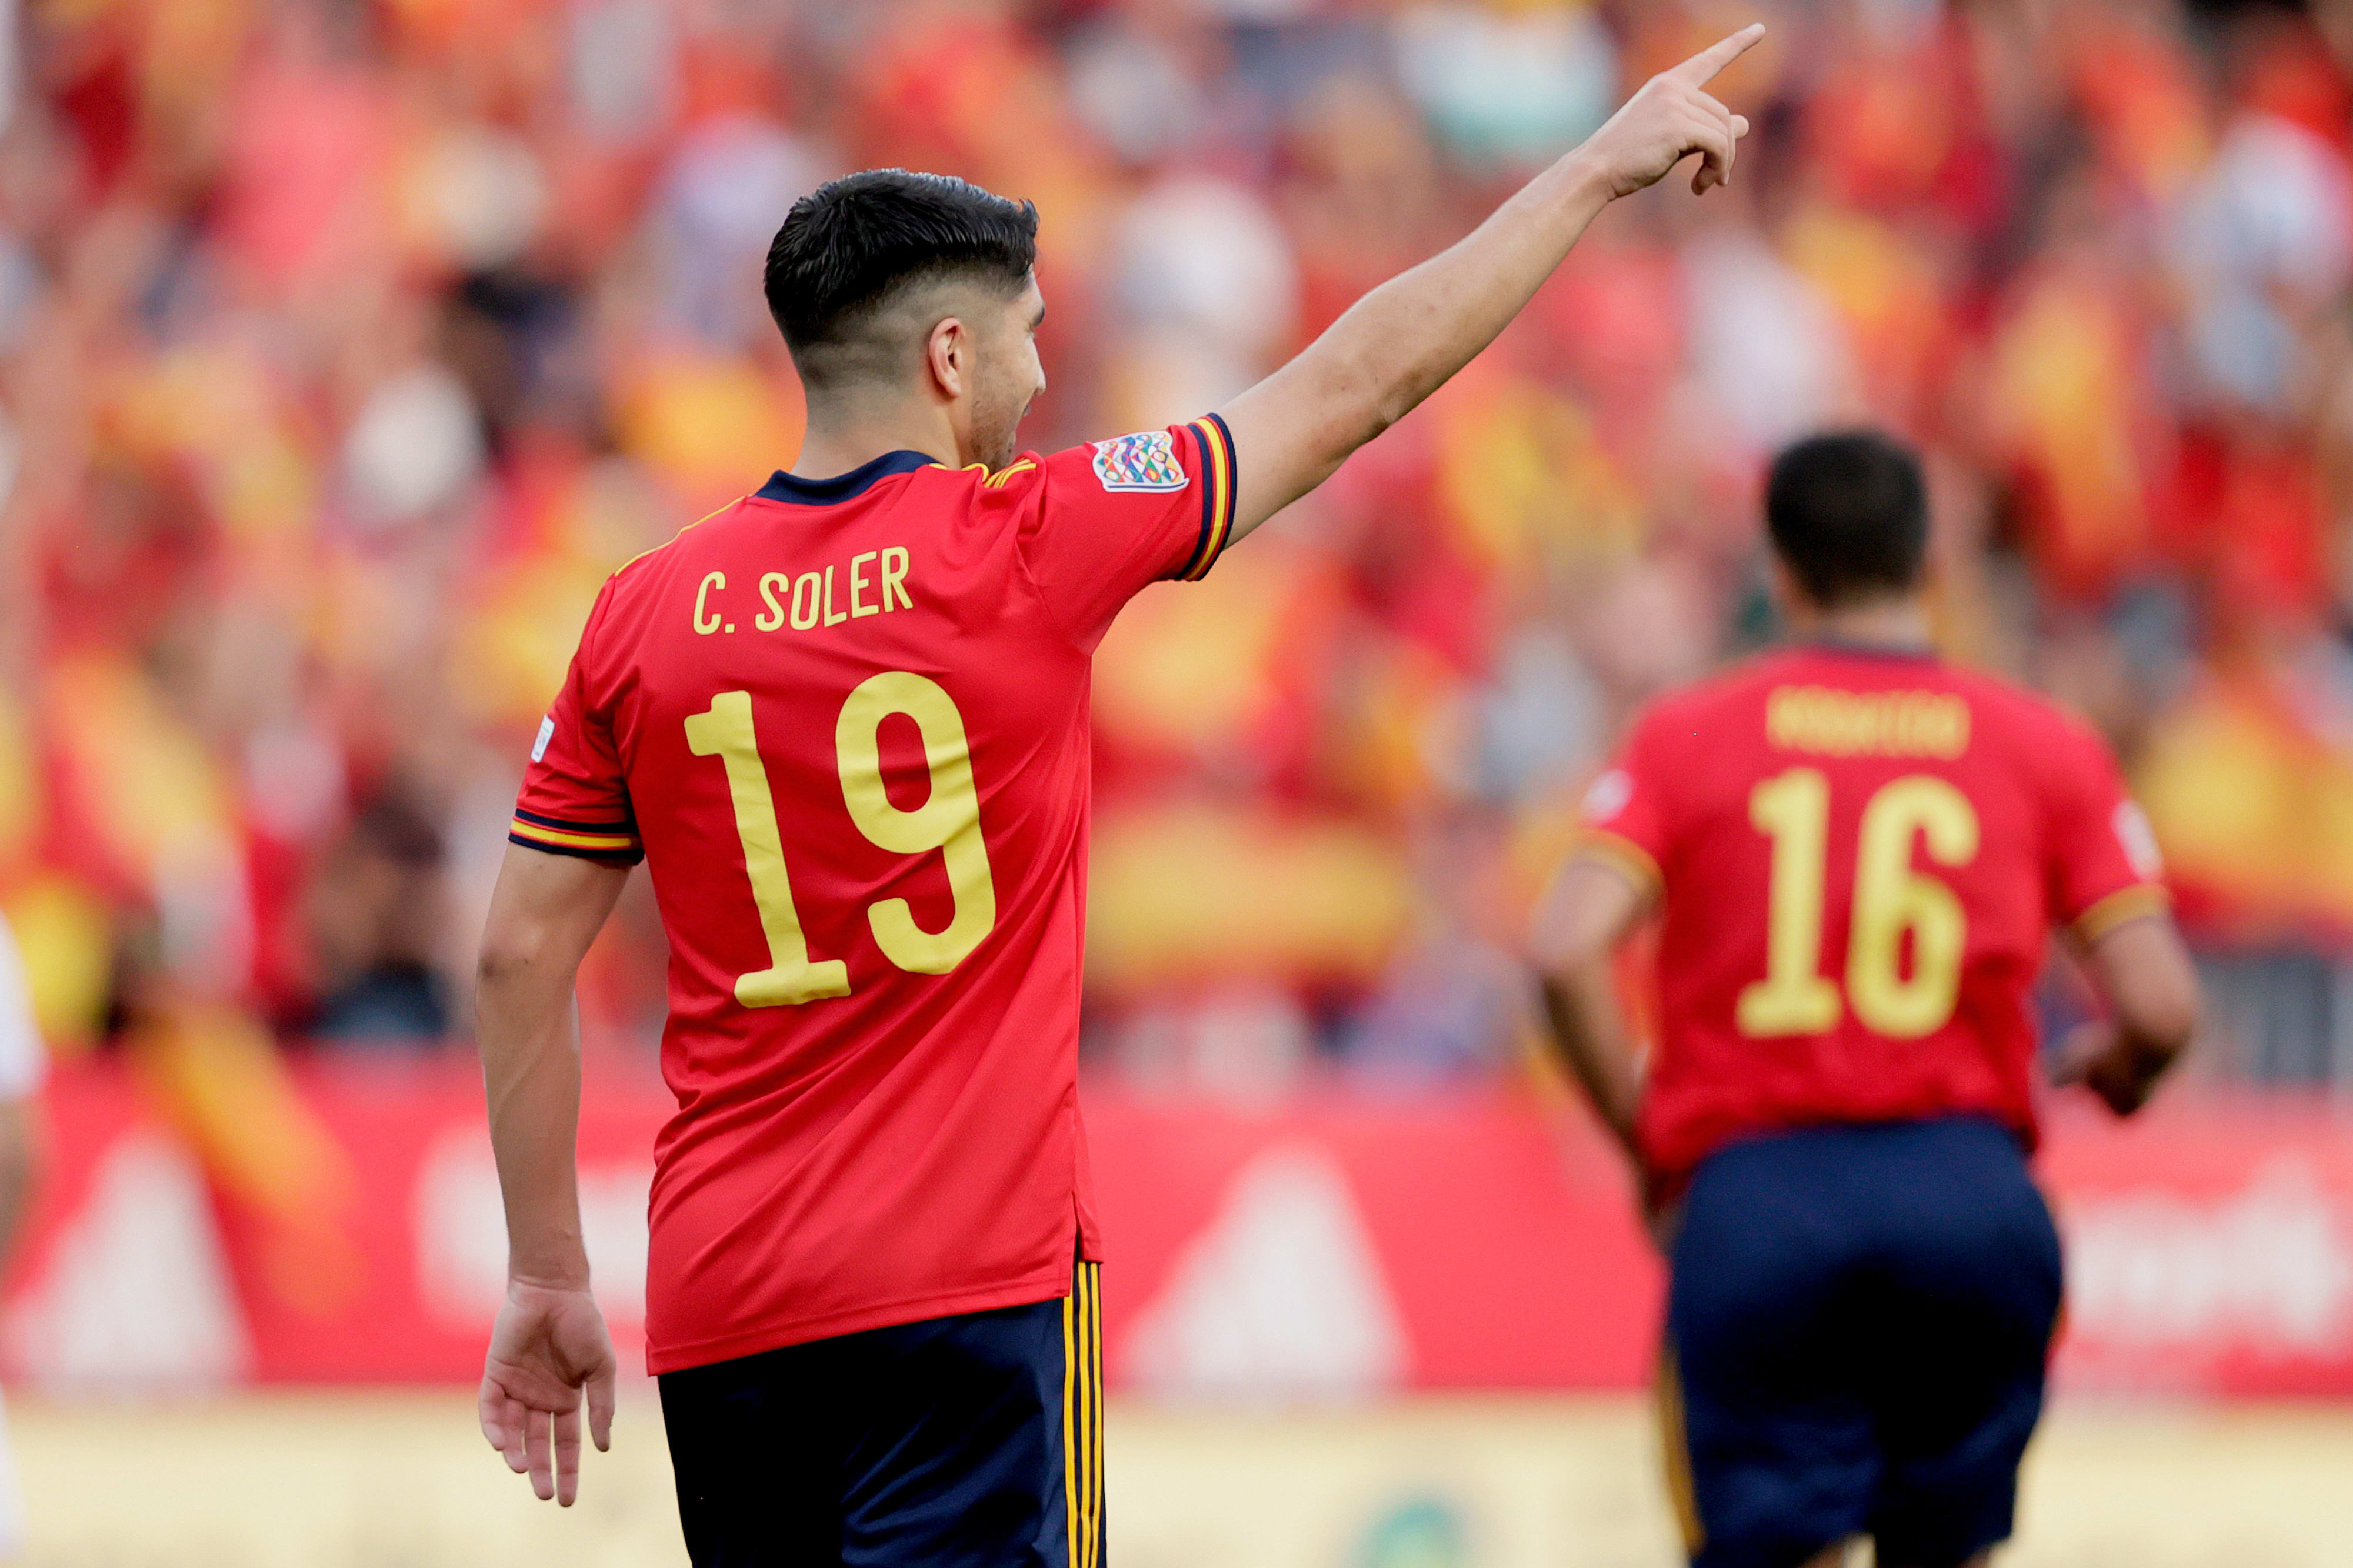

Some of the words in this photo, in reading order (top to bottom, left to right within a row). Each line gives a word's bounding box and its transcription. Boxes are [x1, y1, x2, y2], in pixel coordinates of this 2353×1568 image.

[692, 570, 736, 636] C.
[754, 545, 915, 633] SOLER
[683, 670, 996, 1009] 19
[1735, 766, 1981, 1039] 16
